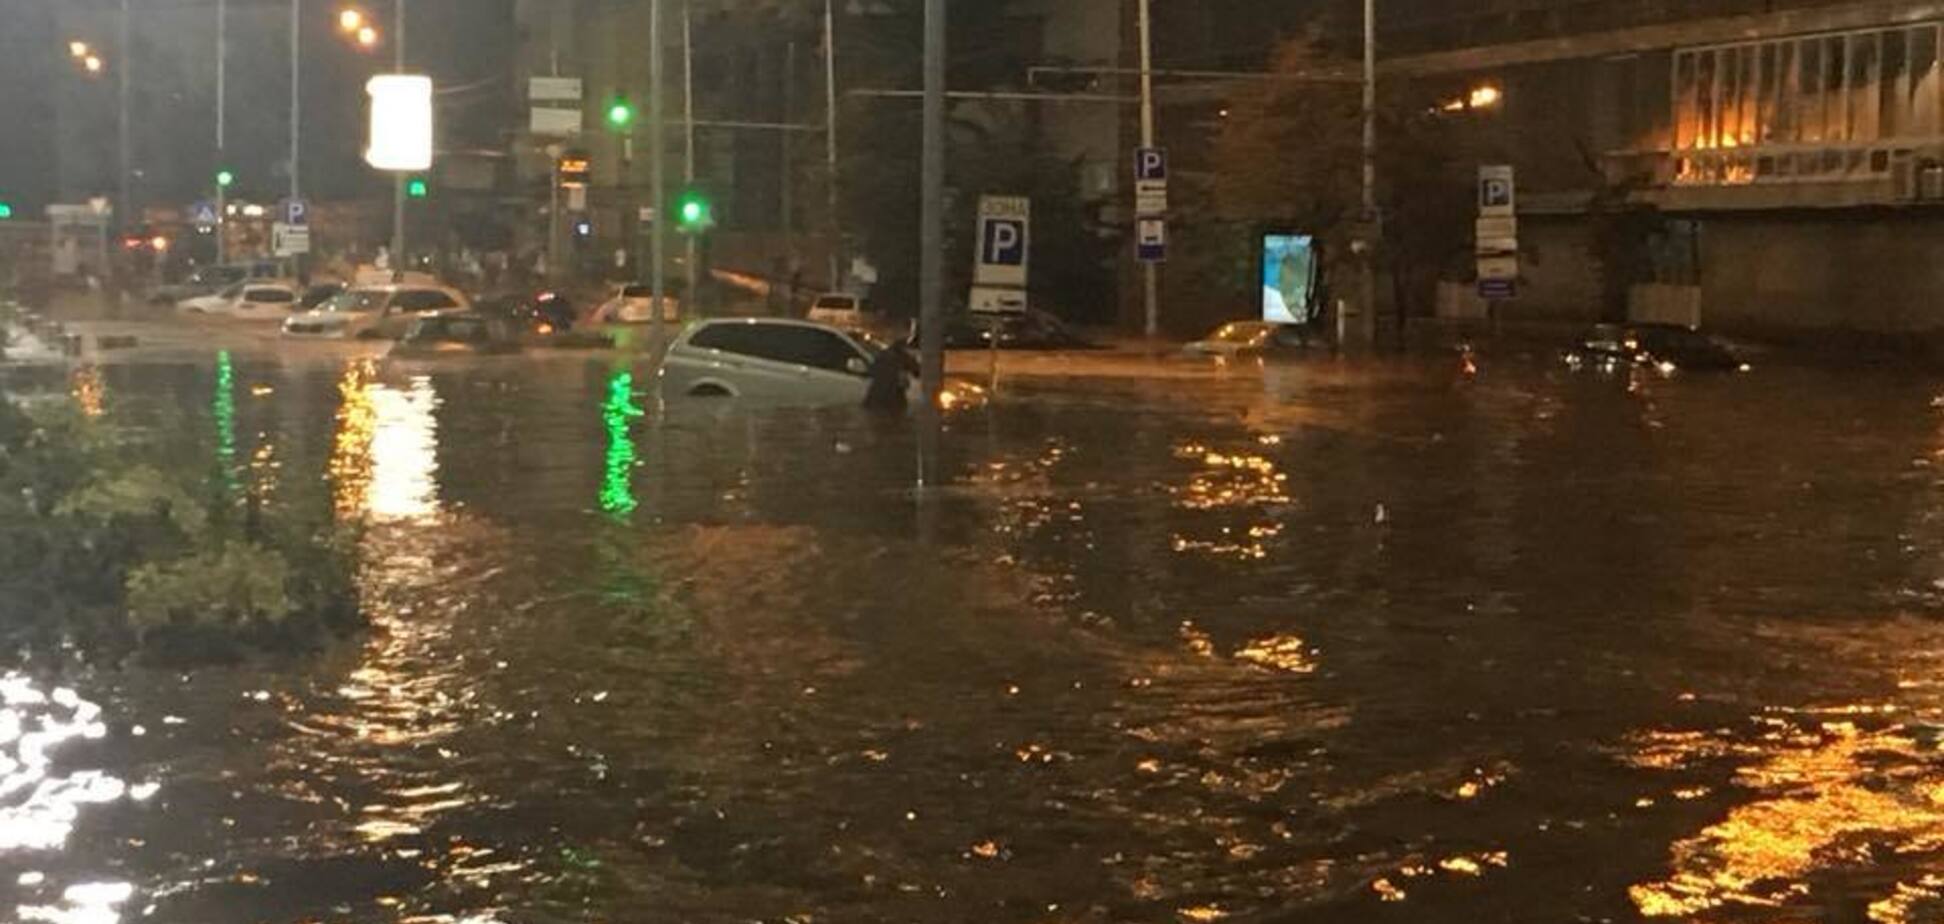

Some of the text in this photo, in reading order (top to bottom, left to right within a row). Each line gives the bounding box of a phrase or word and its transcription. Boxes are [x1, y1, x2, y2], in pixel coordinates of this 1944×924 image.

[1144, 153, 1160, 177] P
[1488, 181, 1505, 204] P
[289, 203, 304, 224] P
[993, 223, 1017, 262] P
